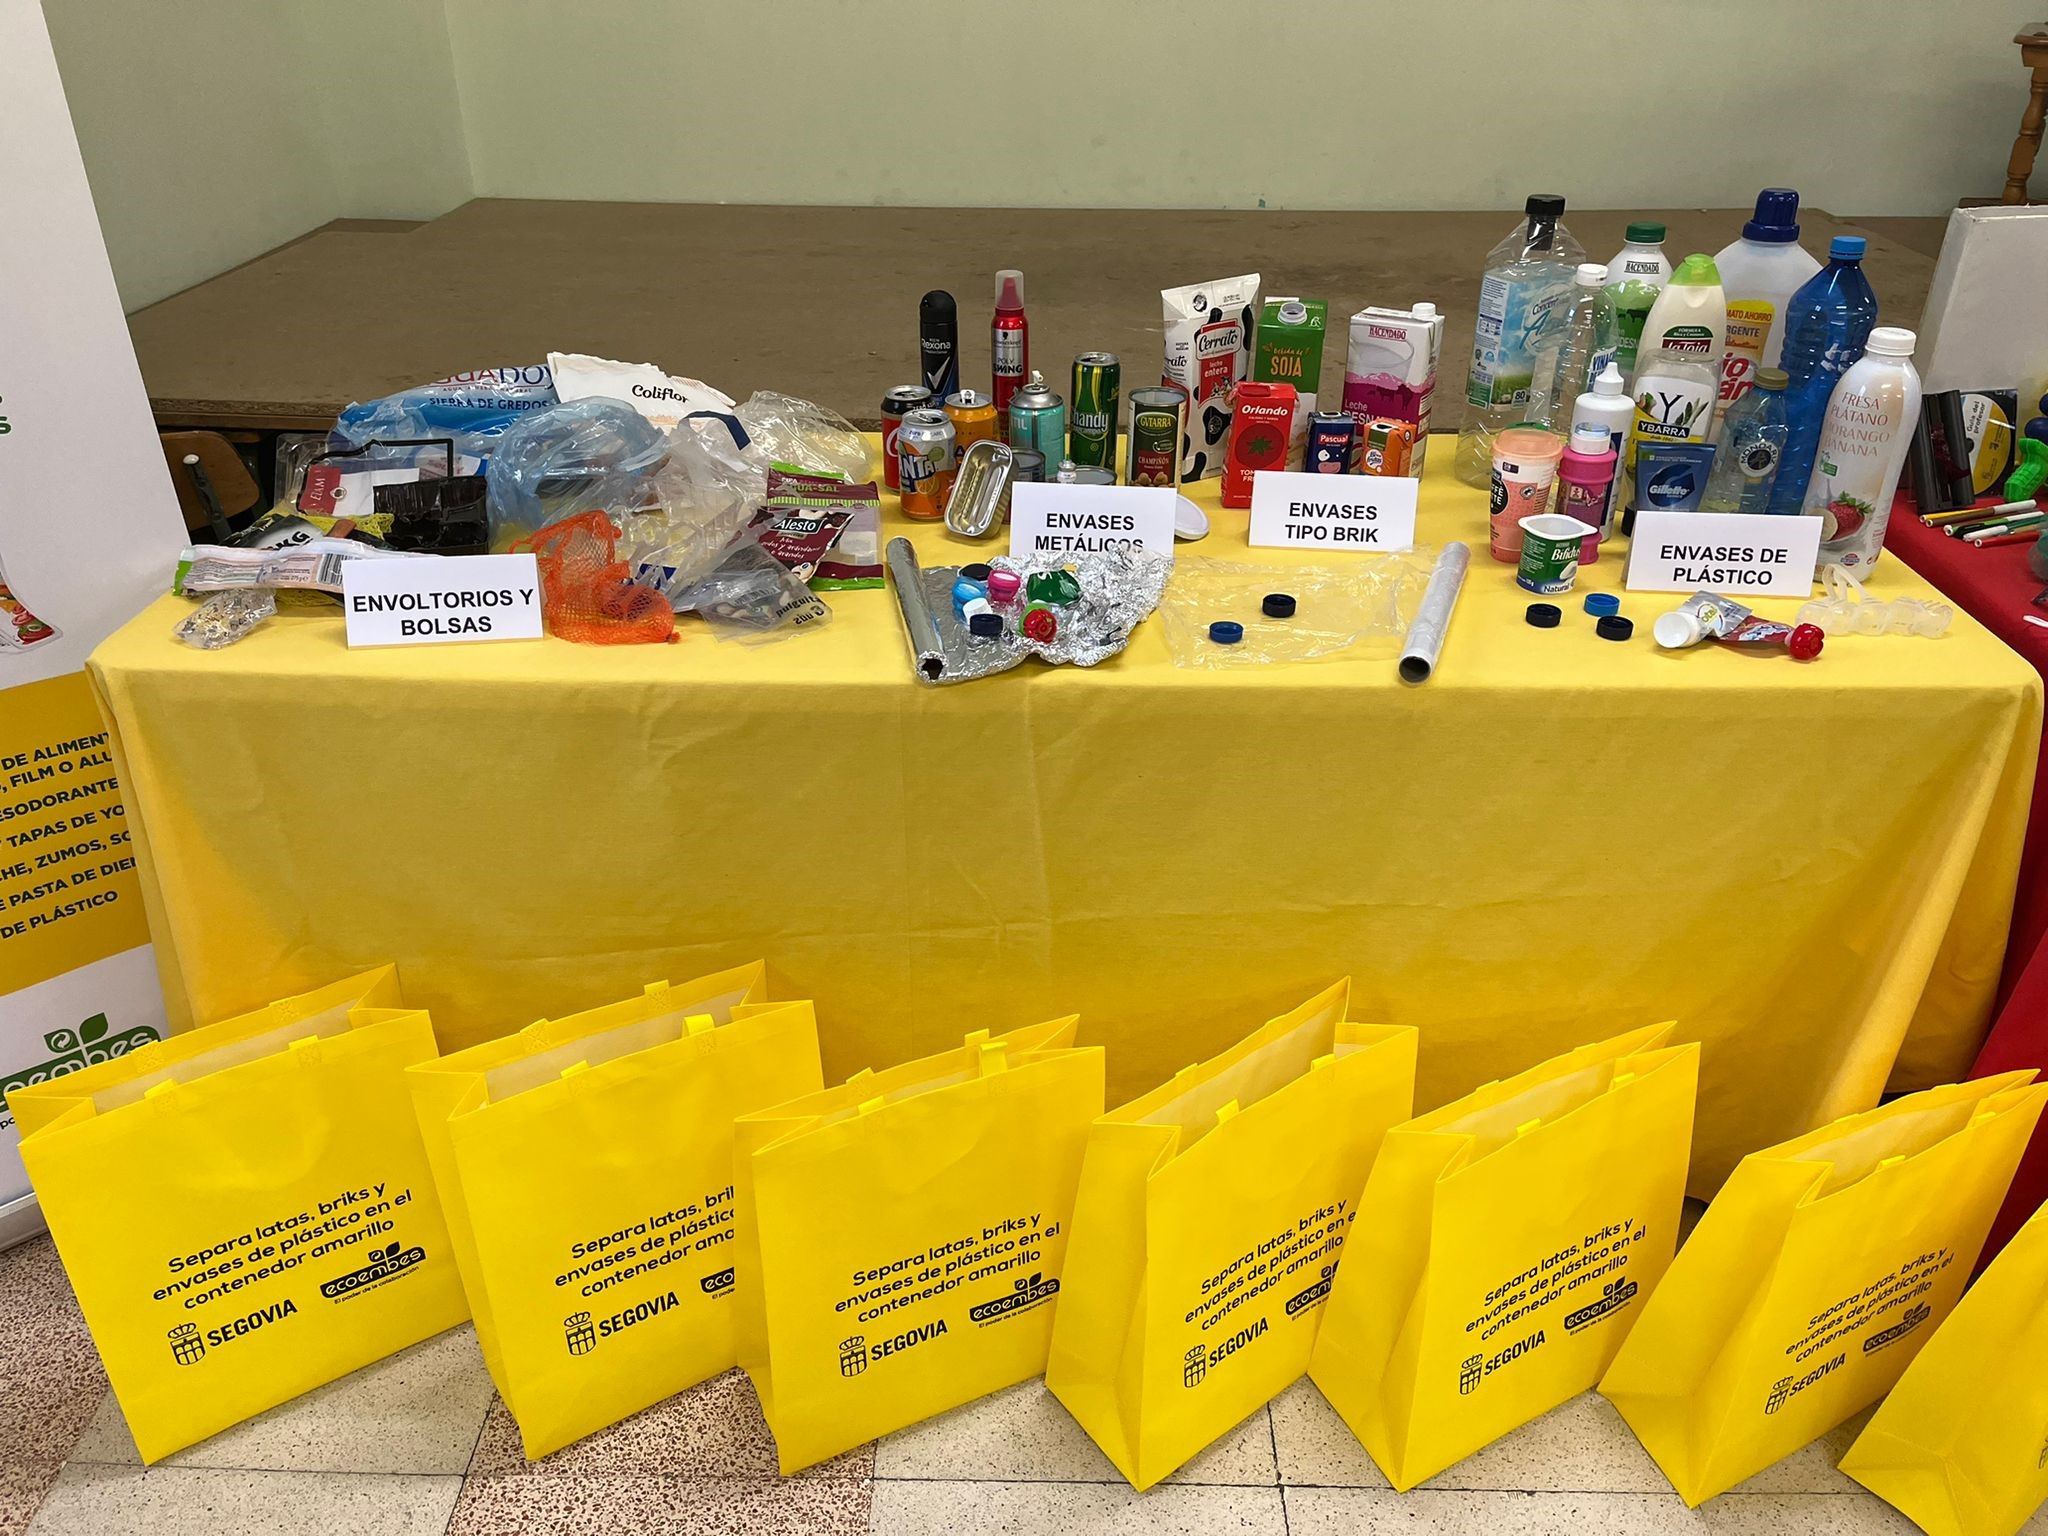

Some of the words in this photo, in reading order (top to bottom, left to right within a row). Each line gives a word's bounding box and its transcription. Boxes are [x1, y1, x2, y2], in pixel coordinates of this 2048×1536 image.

[1626, 261, 1659, 273] HACENDADO
[1745, 311, 1772, 322] AHORRO
[922, 338, 951, 349] Rexona
[1199, 329, 1237, 352] Cerrato
[1369, 326, 1406, 340] HACENDADO
[993, 364, 1022, 374] SWING
[1204, 366, 1228, 377] entera
[1270, 356, 1302, 377] SOJA
[478, 398, 495, 409] DE
[631, 384, 688, 404] Coliflor
[1345, 400, 1368, 411] Leche
[1515, 391, 1526, 400] 80
[1658, 391, 1684, 423] Y
[1841, 391, 1880, 410] FRESA
[1072, 411, 1108, 432] handy
[1241, 405, 1288, 416] Orlando
[1830, 404, 1888, 426] PLÁTANO
[1320, 434, 1348, 443] Pascual
[1640, 422, 1687, 437] YBARRA
[1649, 484, 1688, 495] Gillette
[774, 518, 817, 531] Alesto
[1045, 513, 1135, 531] ENVASES
[1288, 502, 1378, 521] ENVASES
[1035, 534, 1143, 553] METÁLICOS
[1285, 524, 1328, 540] TIPO
[1333, 526, 1378, 542] BRIK
[1660, 545, 1753, 563] ENVASES
[1758, 548, 1788, 564] DE
[1543, 581, 1570, 593] Natural
[1673, 566, 1773, 586] PLÁSTICO
[353, 592, 512, 612] ENVOLTORIOS
[519, 589, 534, 605] Y
[401, 616, 492, 636] BOLSAS
[1, 753, 28, 771] DE
[9, 765, 55, 788] FILM
[58, 761, 73, 773] O
[0, 778, 119, 821] SODORANTE
[6, 821, 67, 847] TAPAS
[70, 812, 97, 828] DE
[35, 839, 107, 868] ZUMOS,
[9, 879, 69, 907] PASTA
[71, 868, 98, 885] DE
[0, 921, 27, 939] DE
[29, 890, 118, 929] PLÁSTICO
[168, 1236, 252, 1273] Separa
[256, 1213, 316, 1240] latas,
[318, 1190, 370, 1216] briks
[373, 1182, 386, 1198] y
[571, 1223, 646, 1259] Separa
[649, 1203, 702, 1230] latas,
[152, 1260, 244, 1301] envases
[248, 1245, 276, 1262] de
[281, 1211, 360, 1252] plástico
[364, 1202, 390, 1217] en
[394, 1189, 412, 1206] el
[853, 1253, 925, 1286] Separa
[929, 1237, 978, 1260] latas,
[983, 1217, 1026, 1240] briks
[1031, 1213, 1041, 1227] y
[1201, 1252, 1254, 1294] Separa
[1258, 1229, 1295, 1258] latas,
[1299, 1204, 1334, 1231] briks
[1338, 1200, 1347, 1213] y
[184, 1252, 308, 1309] contenedor
[310, 1220, 394, 1258] amarillo
[325, 1249, 422, 1296] ecoembes
[555, 1246, 636, 1286] envases
[640, 1237, 665, 1252] de
[581, 1241, 691, 1297] contenedor
[835, 1276, 913, 1313] envases
[917, 1265, 941, 1282] de
[945, 1240, 1015, 1276] plástico
[1019, 1232, 1040, 1246] en
[1045, 1222, 1060, 1237] el
[1185, 1276, 1244, 1323] envases
[1248, 1263, 1266, 1281] de
[1270, 1229, 1324, 1272] plástico
[1327, 1218, 1344, 1233] en
[1484, 1266, 1538, 1306] Separa
[1541, 1245, 1580, 1272] latas,
[1584, 1222, 1621, 1249] briks
[1624, 1218, 1633, 1232] y
[858, 1274, 964, 1323] contenedor
[968, 1250, 1041, 1281] amarillo
[1201, 1270, 1284, 1331] contenedor
[1287, 1236, 1343, 1275] amarillo
[1466, 1289, 1526, 1332] envases
[1530, 1277, 1549, 1295] de
[1551, 1247, 1609, 1287] plástico
[1613, 1237, 1630, 1251] en
[1633, 1225, 1646, 1241] el
[1808, 1294, 1859, 1330] Separa
[1862, 1271, 1897, 1299] latas,
[1901, 1254, 1935, 1275] briks
[1938, 1248, 1947, 1260] y
[973, 1280, 1057, 1320] ecoembes
[1481, 1284, 1565, 1341] contenedor
[1568, 1255, 1628, 1290] amarillo
[1567, 1284, 1635, 1327] ecoembes
[1786, 1318, 1843, 1355] envases
[1846, 1305, 1865, 1319] de
[1868, 1273, 1919, 1311] plástico
[1921, 1266, 1939, 1278] en
[1942, 1253, 1954, 1268] el
[207, 1299, 298, 1347] SEGOVIA
[599, 1291, 680, 1337] SEGOVIA
[1796, 1313, 1878, 1363] contenedor
[1877, 1282, 1932, 1315] amarillo
[871, 1320, 948, 1361] SEGOVIA
[1209, 1317, 1269, 1368] SEGOVIA
[1484, 1330, 1546, 1376] SEGOVIA
[1789, 1353, 1846, 1397] SEGOVIA
